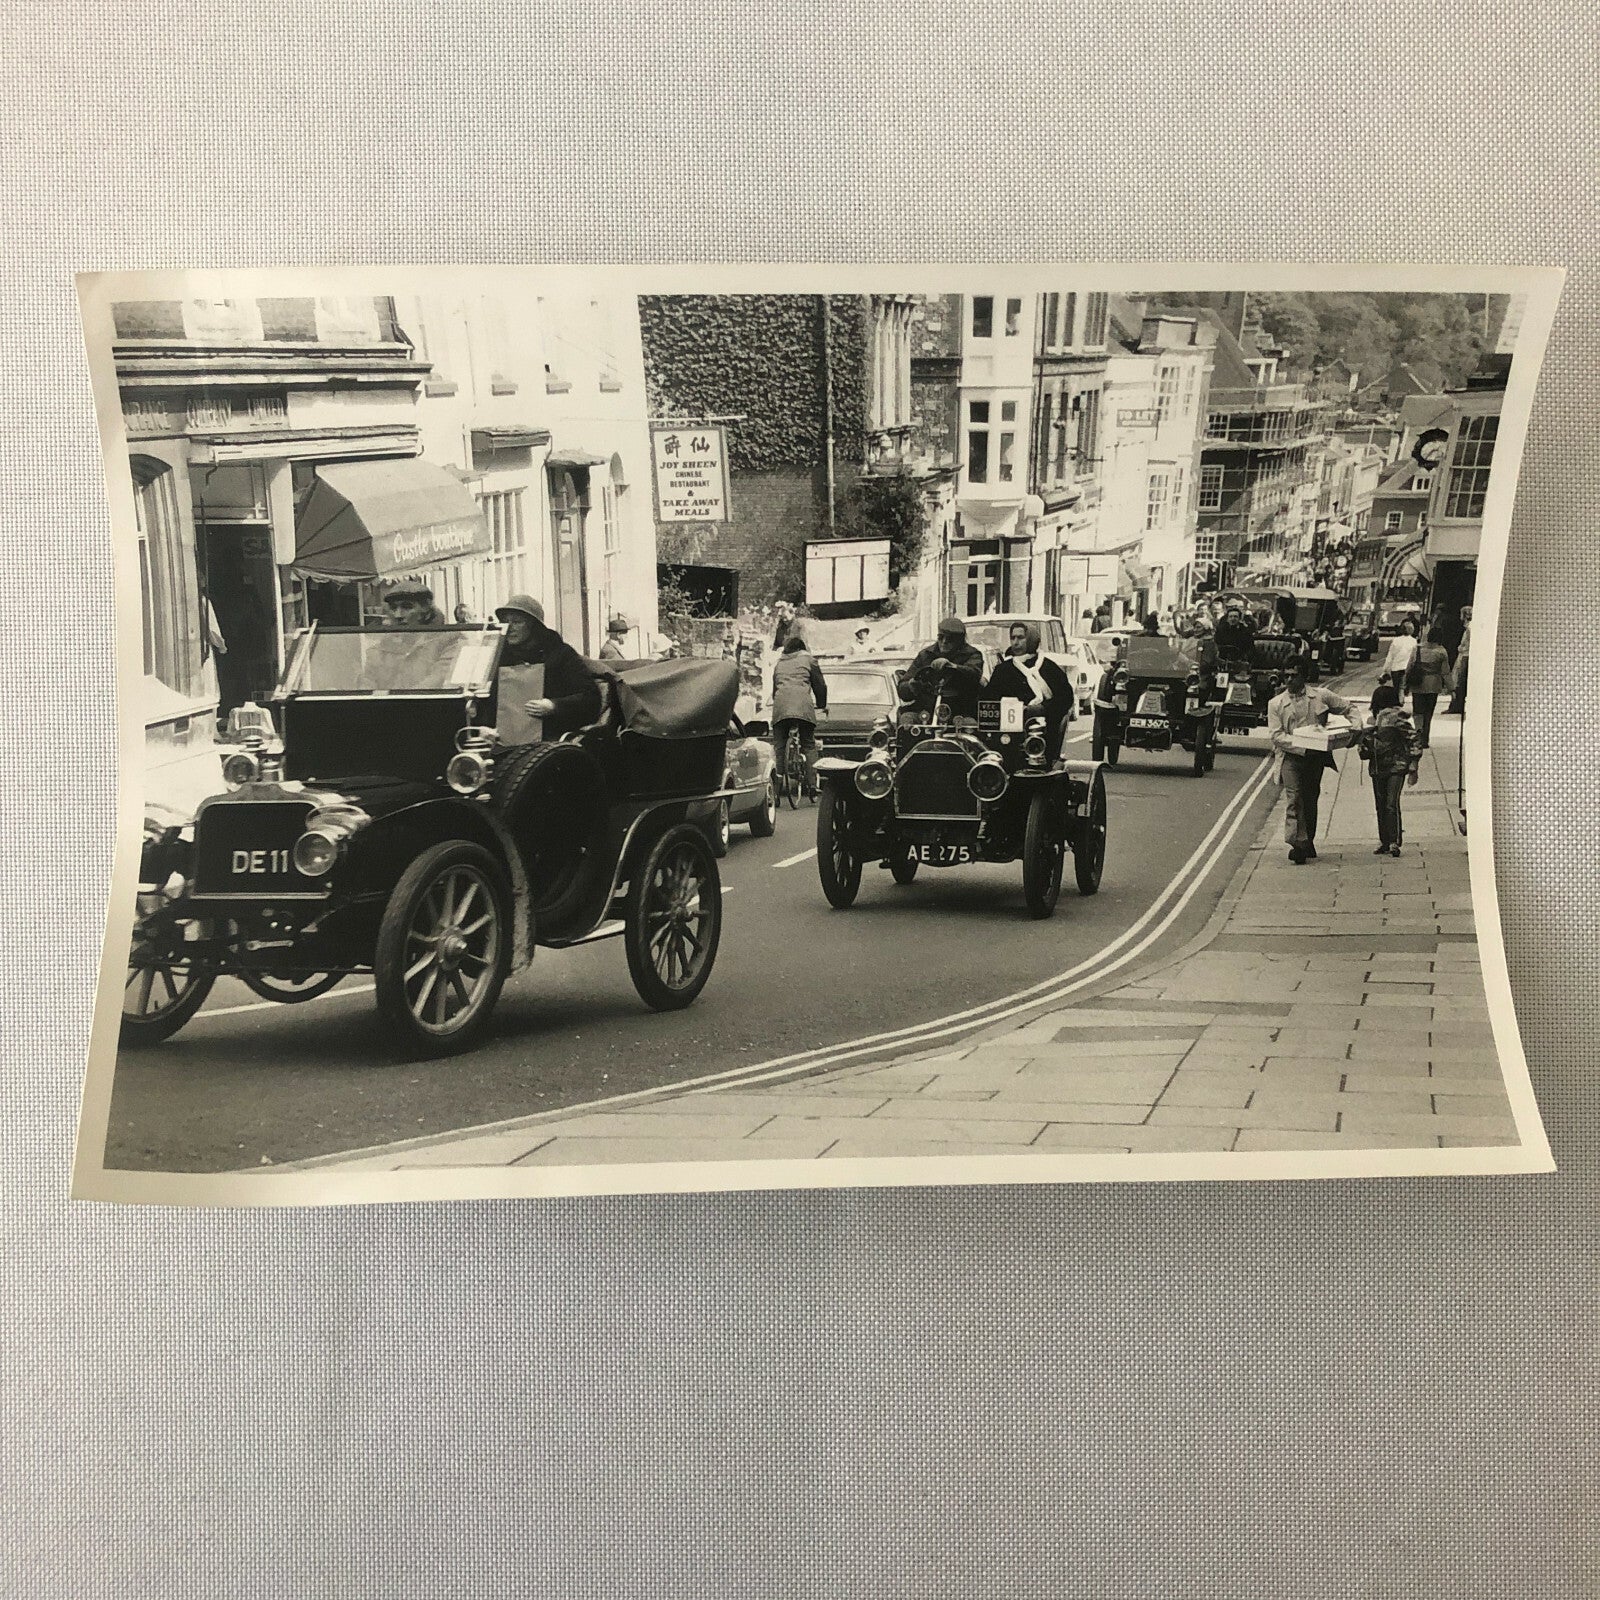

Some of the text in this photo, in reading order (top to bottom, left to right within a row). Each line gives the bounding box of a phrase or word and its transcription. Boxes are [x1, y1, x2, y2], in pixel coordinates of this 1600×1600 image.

[660, 460, 717, 469] JOY SHEEN
[669, 480, 710, 488] RESTAURANT
[687, 489, 694, 497] &
[662, 498, 720, 507] TAKE AWAY
[674, 508, 710, 516] MEALS
[393, 528, 429, 564] Castle
[980, 710, 1000, 719] 1903
[1007, 708, 1016, 724] 6
[907, 844, 931, 861] AE
